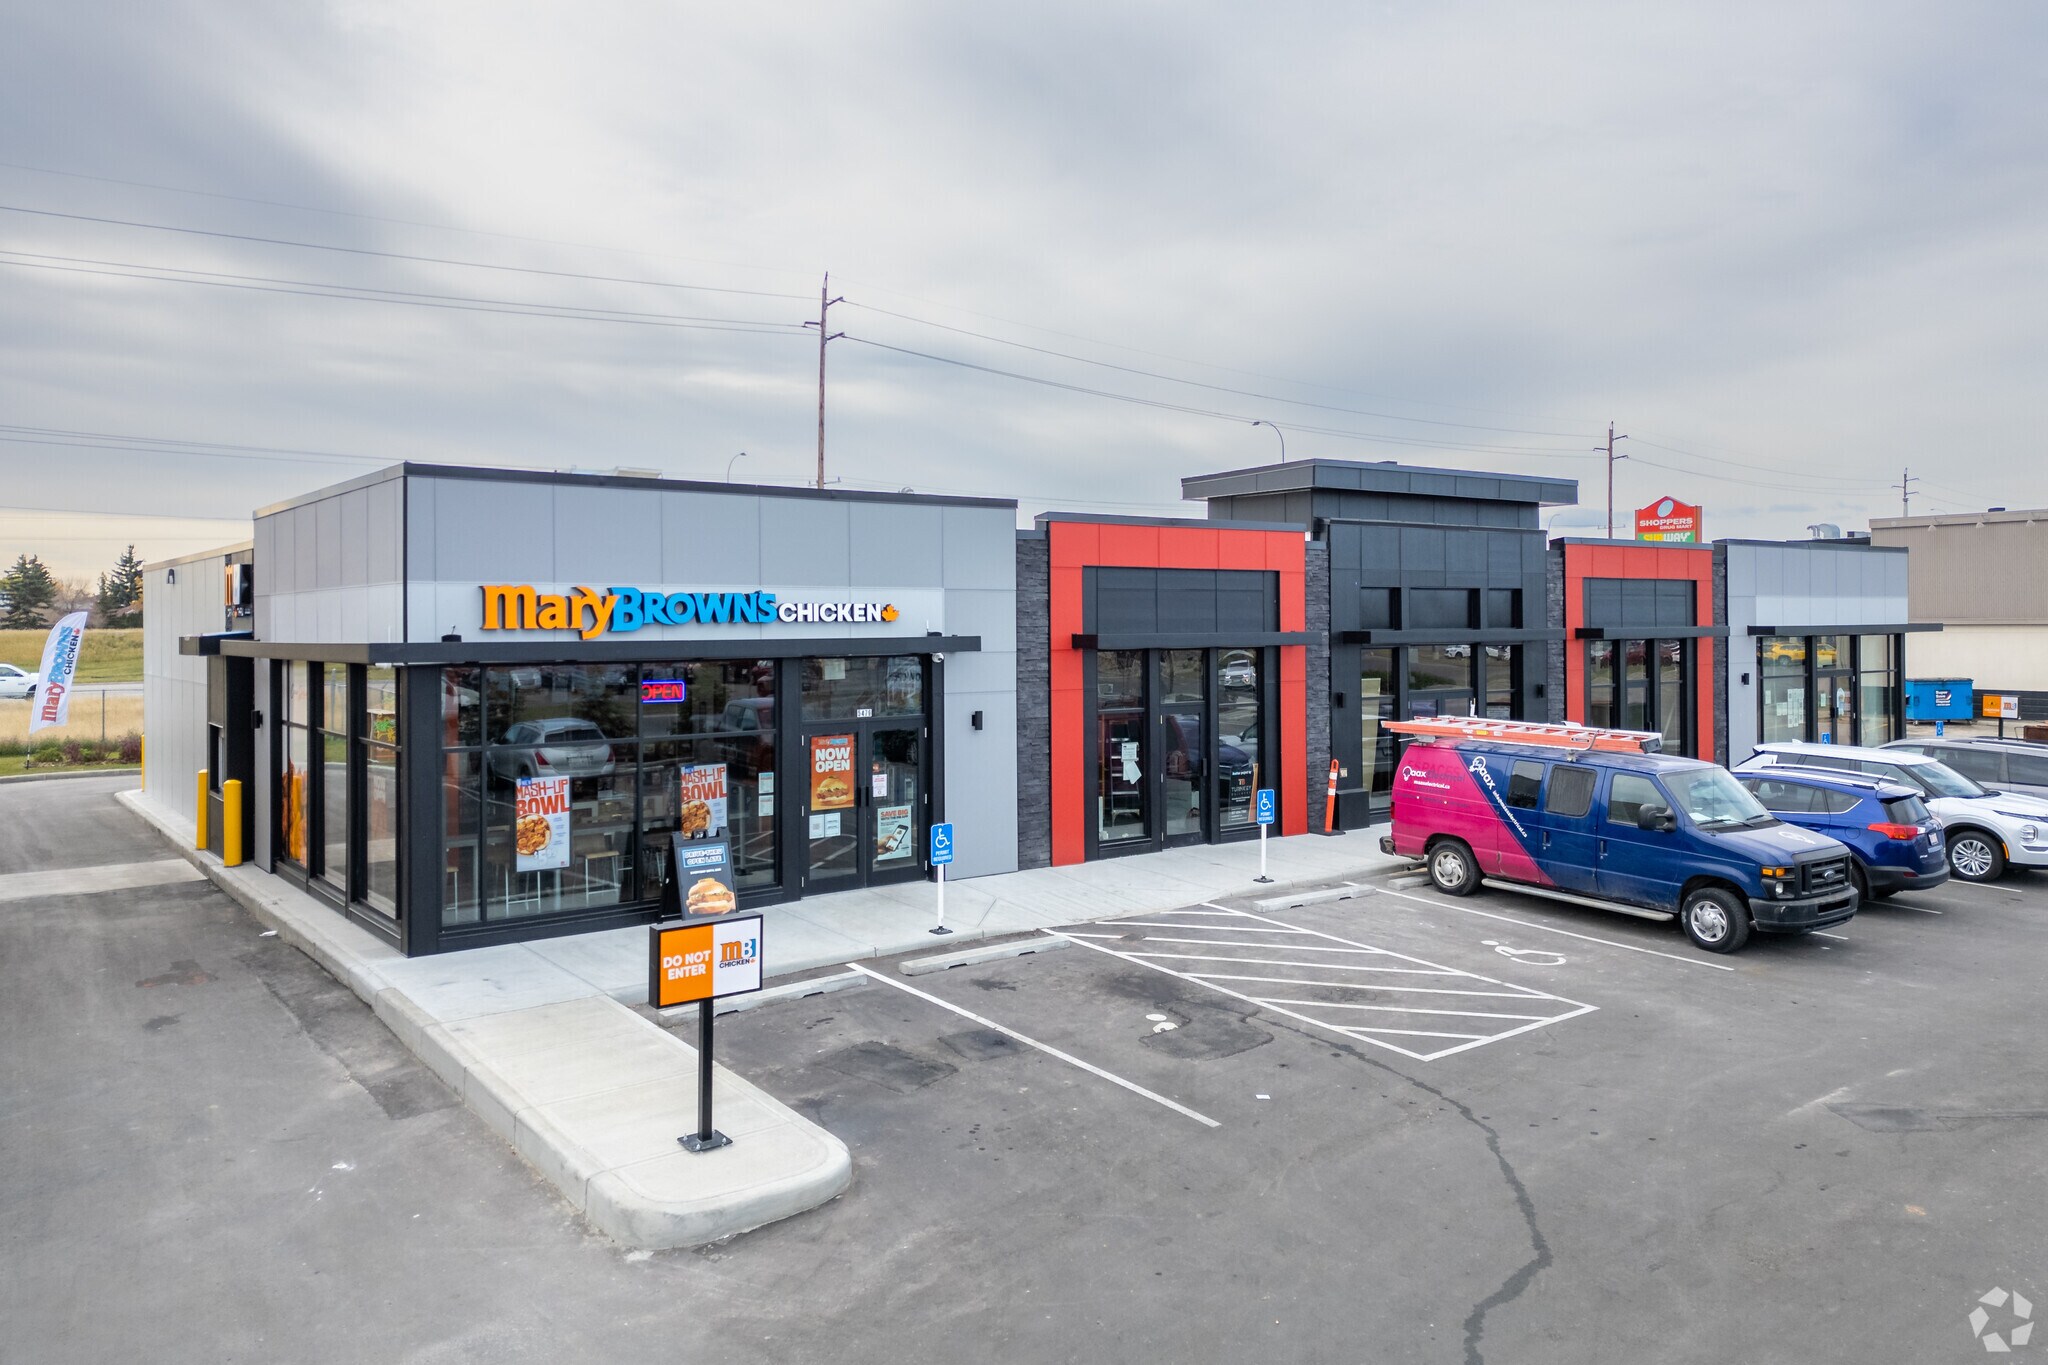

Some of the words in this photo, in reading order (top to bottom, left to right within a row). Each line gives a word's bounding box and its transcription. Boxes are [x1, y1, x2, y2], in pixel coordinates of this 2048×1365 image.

[1640, 517, 1693, 526] SHOPPERS
[778, 602, 882, 622] CHICKEN
[63, 635, 80, 675] CHICKEN
[642, 685, 682, 700] OPEN
[815, 747, 850, 761] NOW
[815, 759, 850, 772] OPEN
[680, 766, 725, 786] MASH-UP
[516, 779, 568, 799] MASH-UP
[681, 779, 727, 802] BOWL
[516, 793, 571, 818] BOWL
[663, 955, 683, 968] DO
[685, 950, 711, 965] NOT
[719, 958, 750, 969] CHICKEN
[667, 963, 706, 981] ENTER
